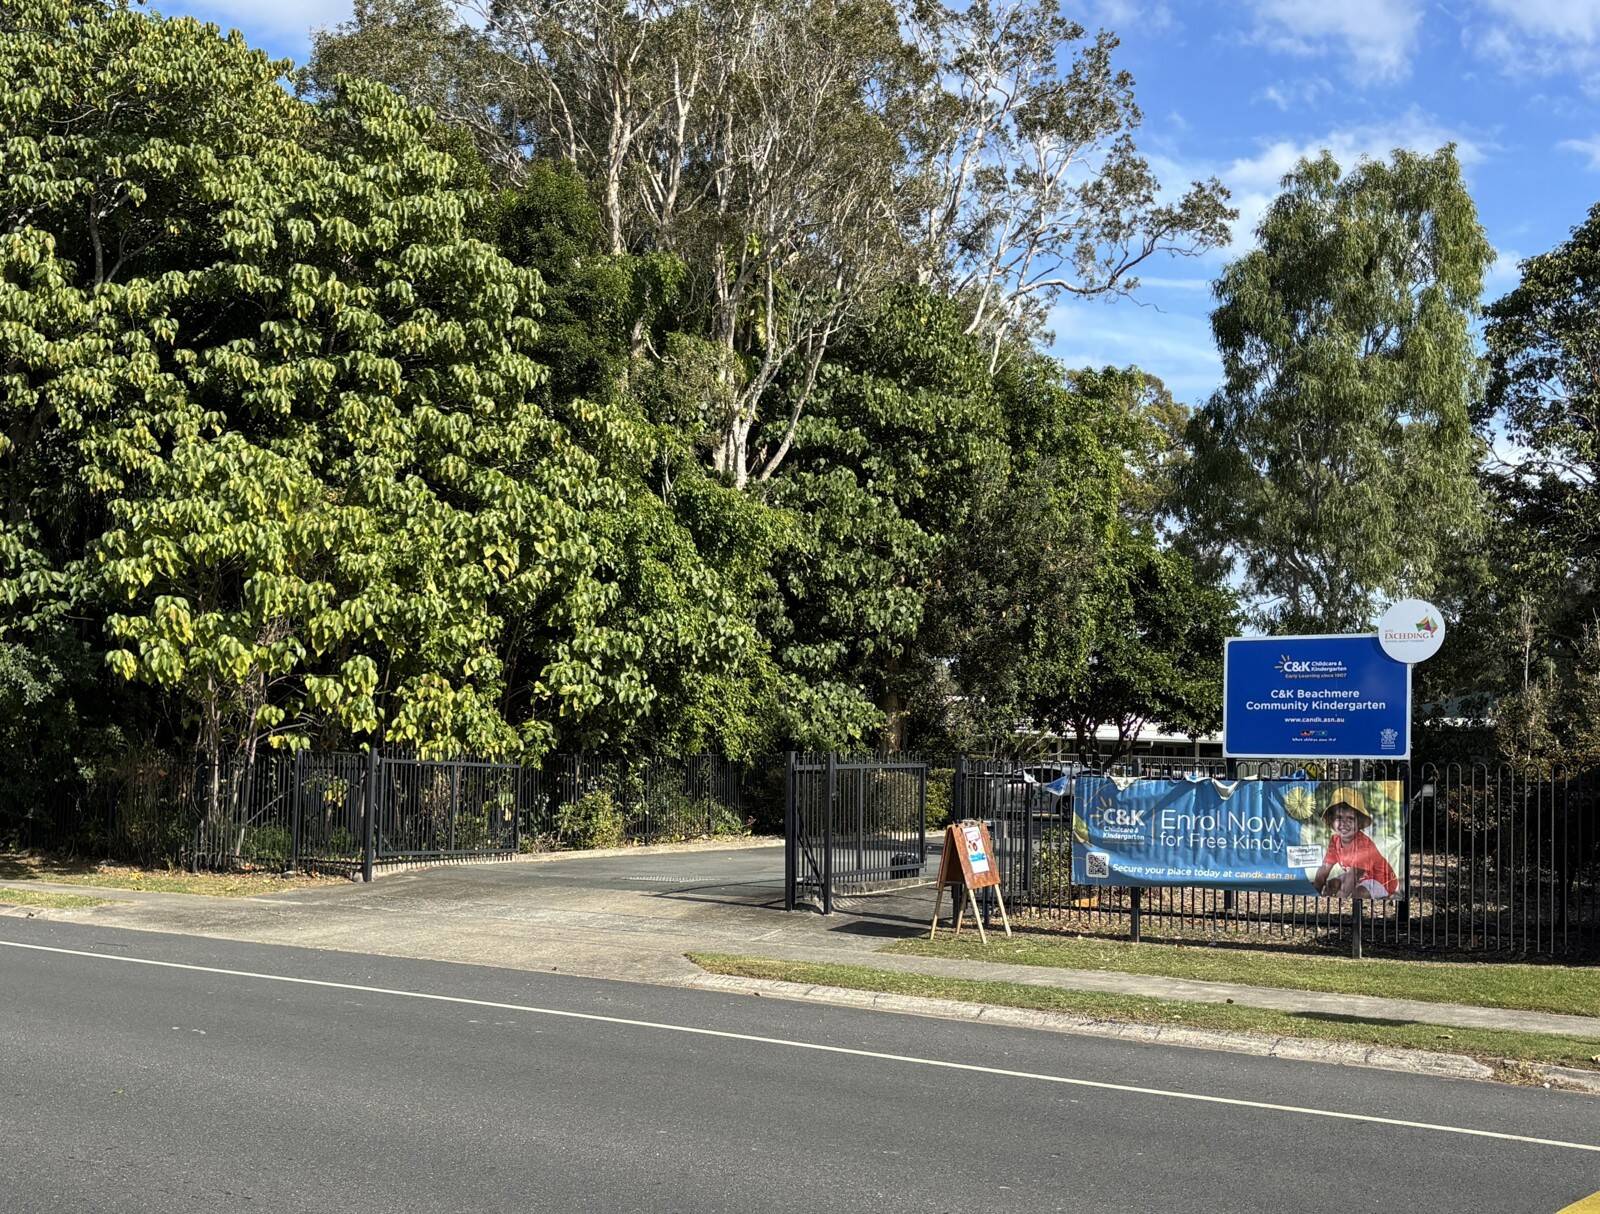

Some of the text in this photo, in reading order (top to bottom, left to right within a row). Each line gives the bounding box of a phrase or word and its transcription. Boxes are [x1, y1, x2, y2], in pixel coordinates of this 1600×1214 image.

[1283, 661, 1310, 672] C&K
[1271, 688, 1360, 699] C&K Beachmere
[1246, 700, 1386, 711] Community Kindergarten
[1103, 808, 1145, 826] C&K
[1161, 809, 1285, 833] Enrol Now
[1103, 832, 1145, 840] Kindergarten
[1160, 832, 1284, 853] for Free Kindy
[1113, 863, 1297, 880] Secure your place today at candk.asn.au
